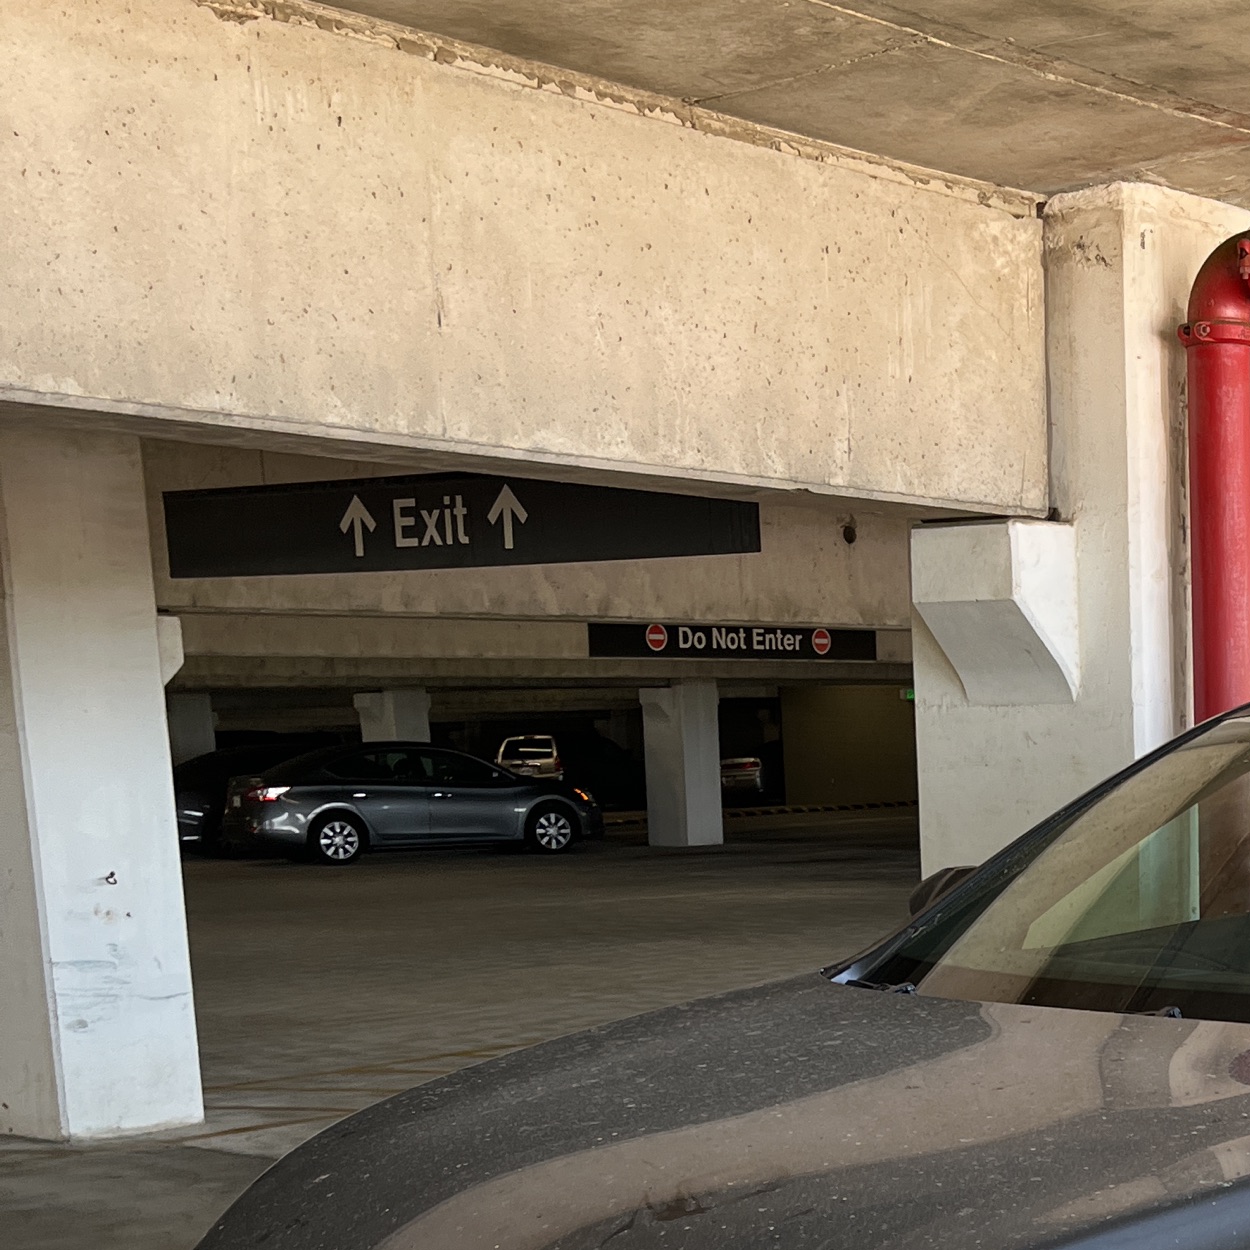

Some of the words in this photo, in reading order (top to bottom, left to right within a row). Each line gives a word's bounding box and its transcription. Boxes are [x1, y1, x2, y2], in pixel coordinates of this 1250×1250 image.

[392, 494, 470, 548] Exit
[678, 626, 707, 649] Do
[711, 627, 748, 650] Not
[752, 628, 803, 651] Enter
